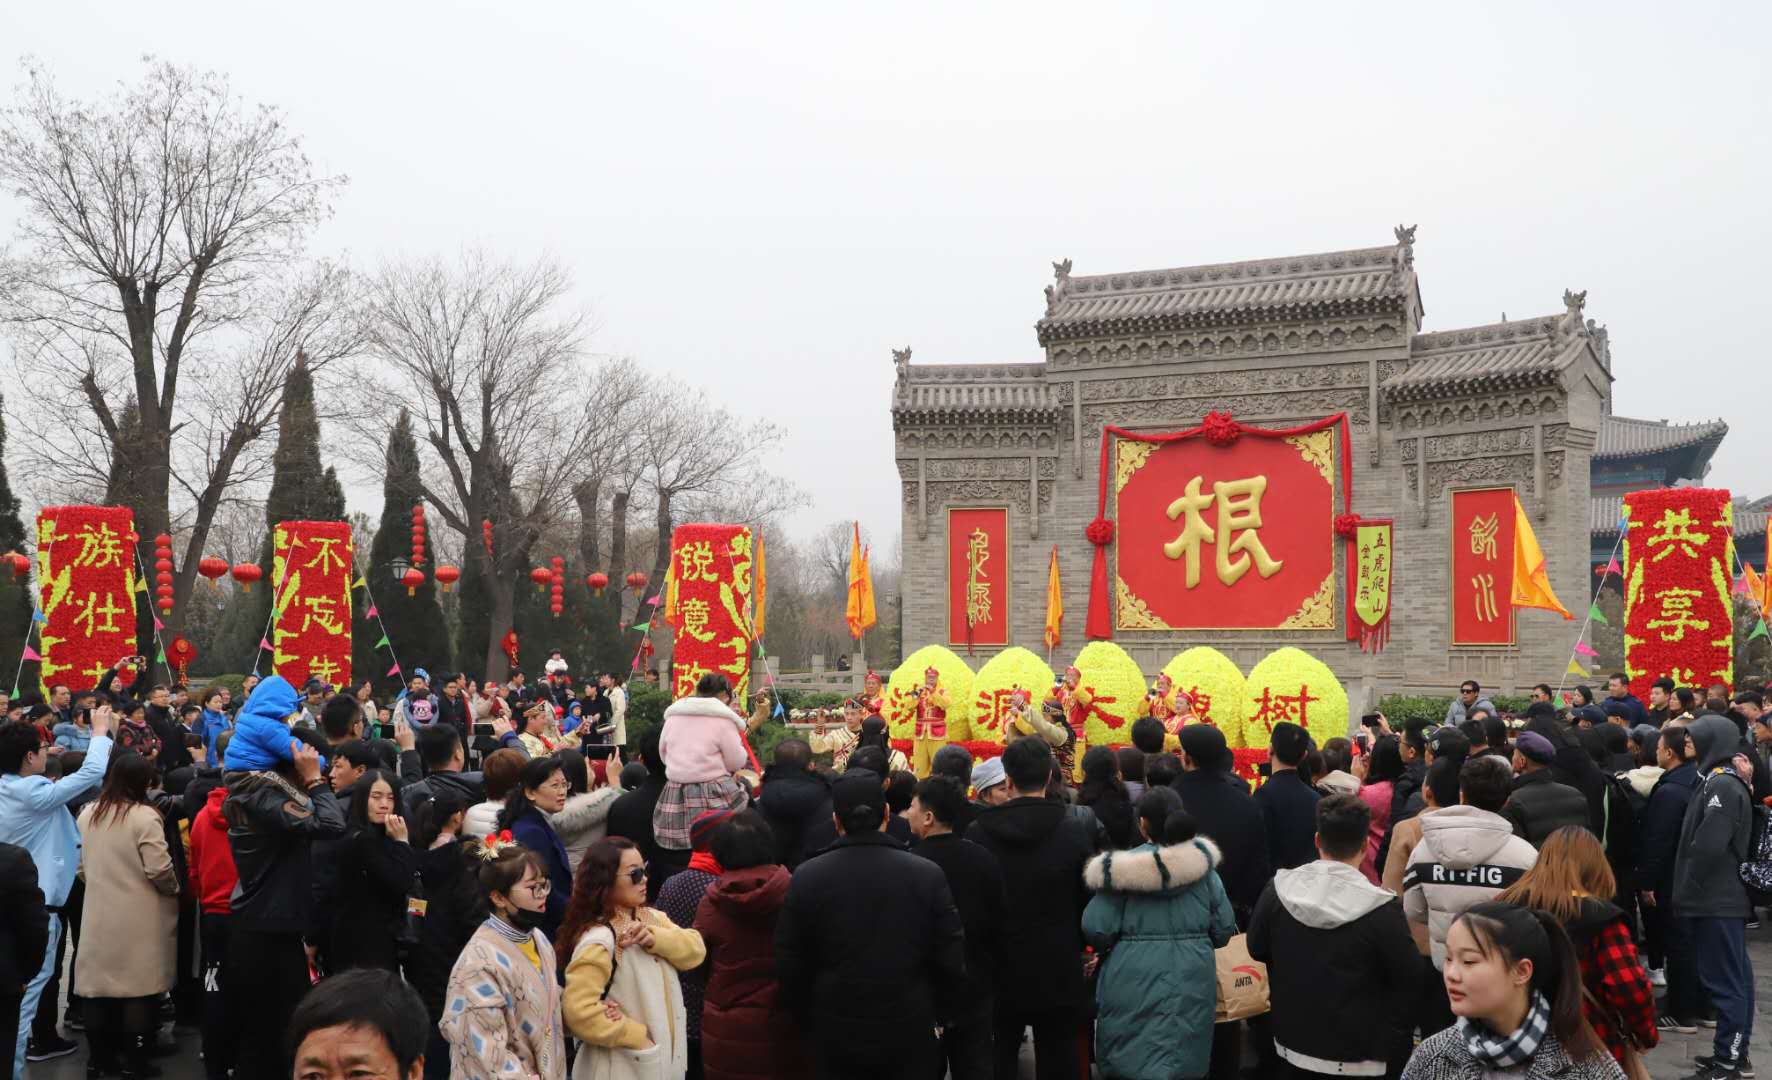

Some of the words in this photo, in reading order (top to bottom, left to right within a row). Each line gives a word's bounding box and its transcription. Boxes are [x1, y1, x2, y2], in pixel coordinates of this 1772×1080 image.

[1164, 475, 1283, 589] 根
[1372, 532, 1387, 613] 五虎爬山
[1234, 975, 1253, 988] ANTA
